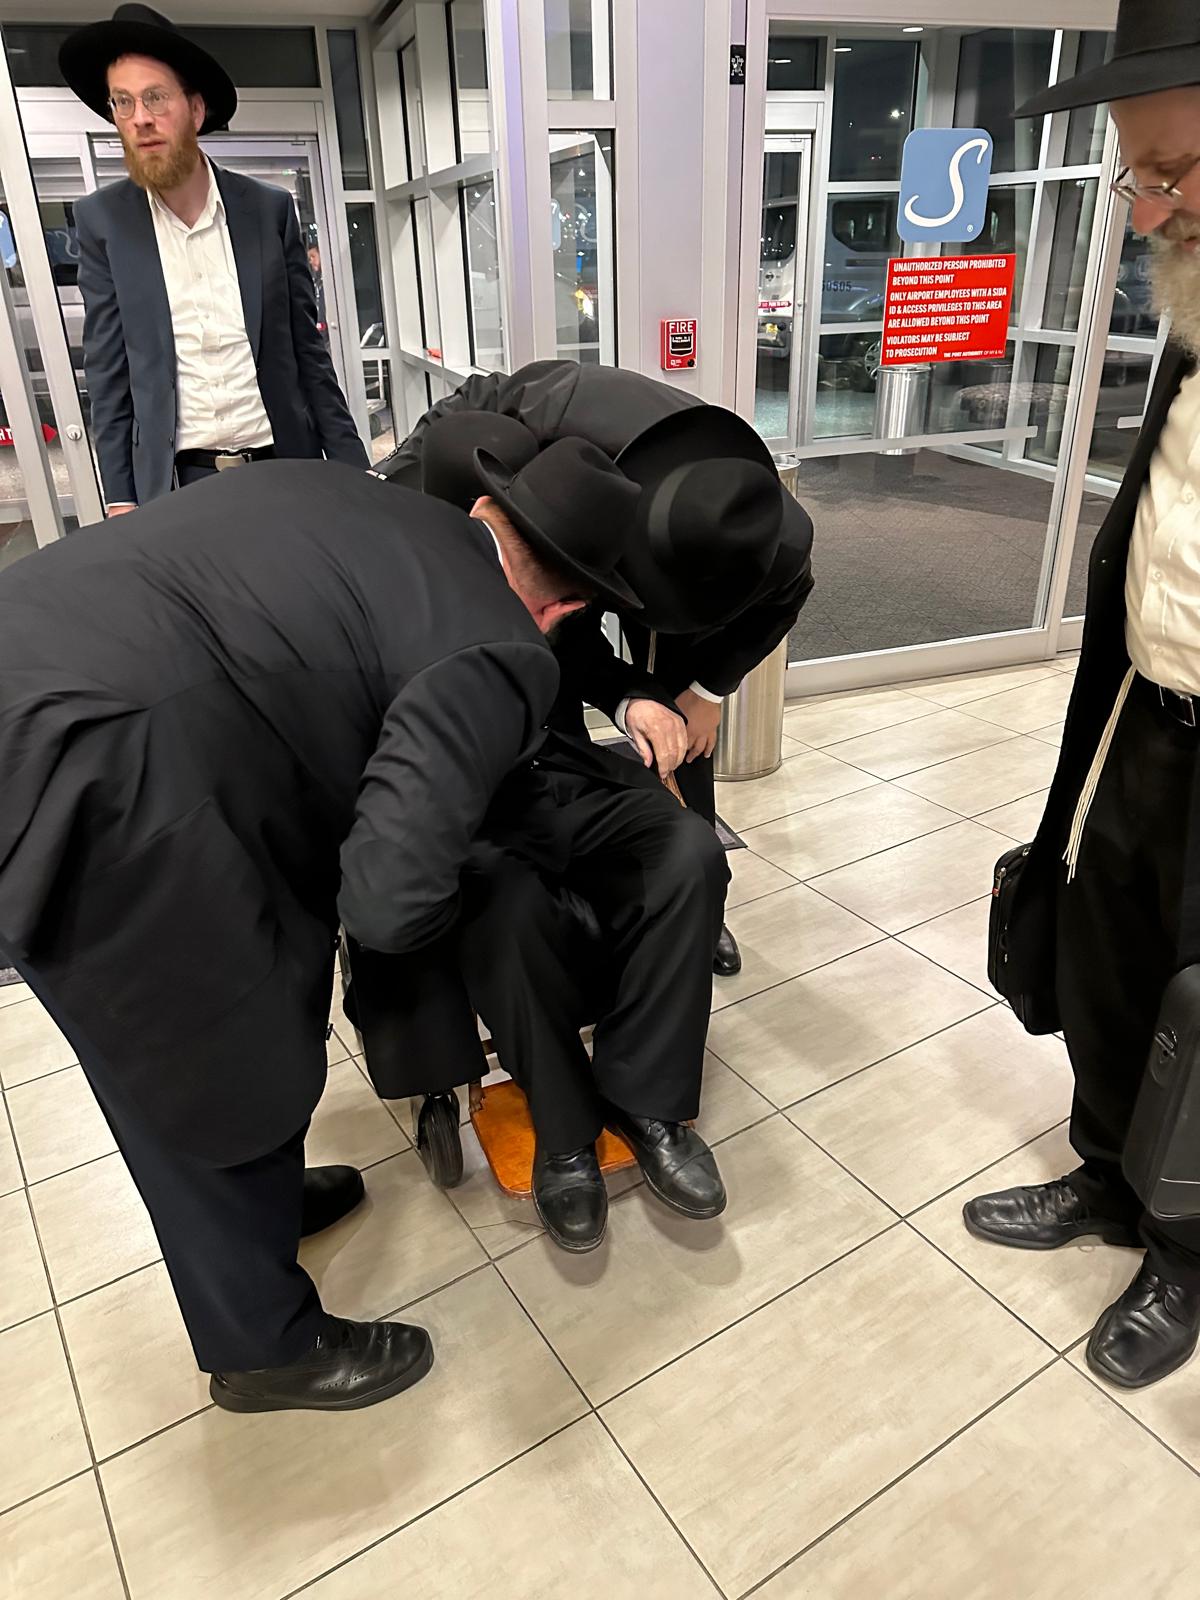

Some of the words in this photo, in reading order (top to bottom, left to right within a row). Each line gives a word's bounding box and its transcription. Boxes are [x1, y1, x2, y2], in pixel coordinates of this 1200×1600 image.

[904, 138, 989, 228] S
[893, 261, 942, 272] UNAUTHORIZED
[944, 260, 968, 270] PERSON
[969, 259, 1006, 269] PROHIBITED
[892, 276, 918, 285] BEYOND
[919, 275, 934, 284] THIS
[935, 274, 954, 283] POINT
[890, 292, 906, 301] ONLY
[907, 291, 934, 300] AIRPORT
[935, 289, 970, 299] EMPLOYEES
[971, 289, 987, 297] WITH
[987, 288, 992, 296] A
[993, 287, 1007, 296] SIDA
[889, 305, 896, 315] ID
[897, 305, 901, 314] &
[902, 304, 927, 314] ACCESS
[928, 303, 963, 312] PRIVILEGES
[964, 302, 971, 310] TO
[972, 302, 987, 310] THIS
[987, 301, 1002, 309] AREA
[669, 321, 694, 333] FIRE
[888, 319, 900, 328] ARE
[901, 317, 930, 327] ALLOWED
[931, 316, 955, 326] BEYOND
[956, 315, 970, 324] THIS
[971, 314, 989, 324] POINT
[887, 335, 920, 345] VIOLATORS
[921, 334, 935, 343] MAY
[935, 333, 943, 342] BE
[944, 332, 970, 341] SUBJECT
[886, 349, 894, 358] TO
[895, 347, 937, 357] PROSECUTION
